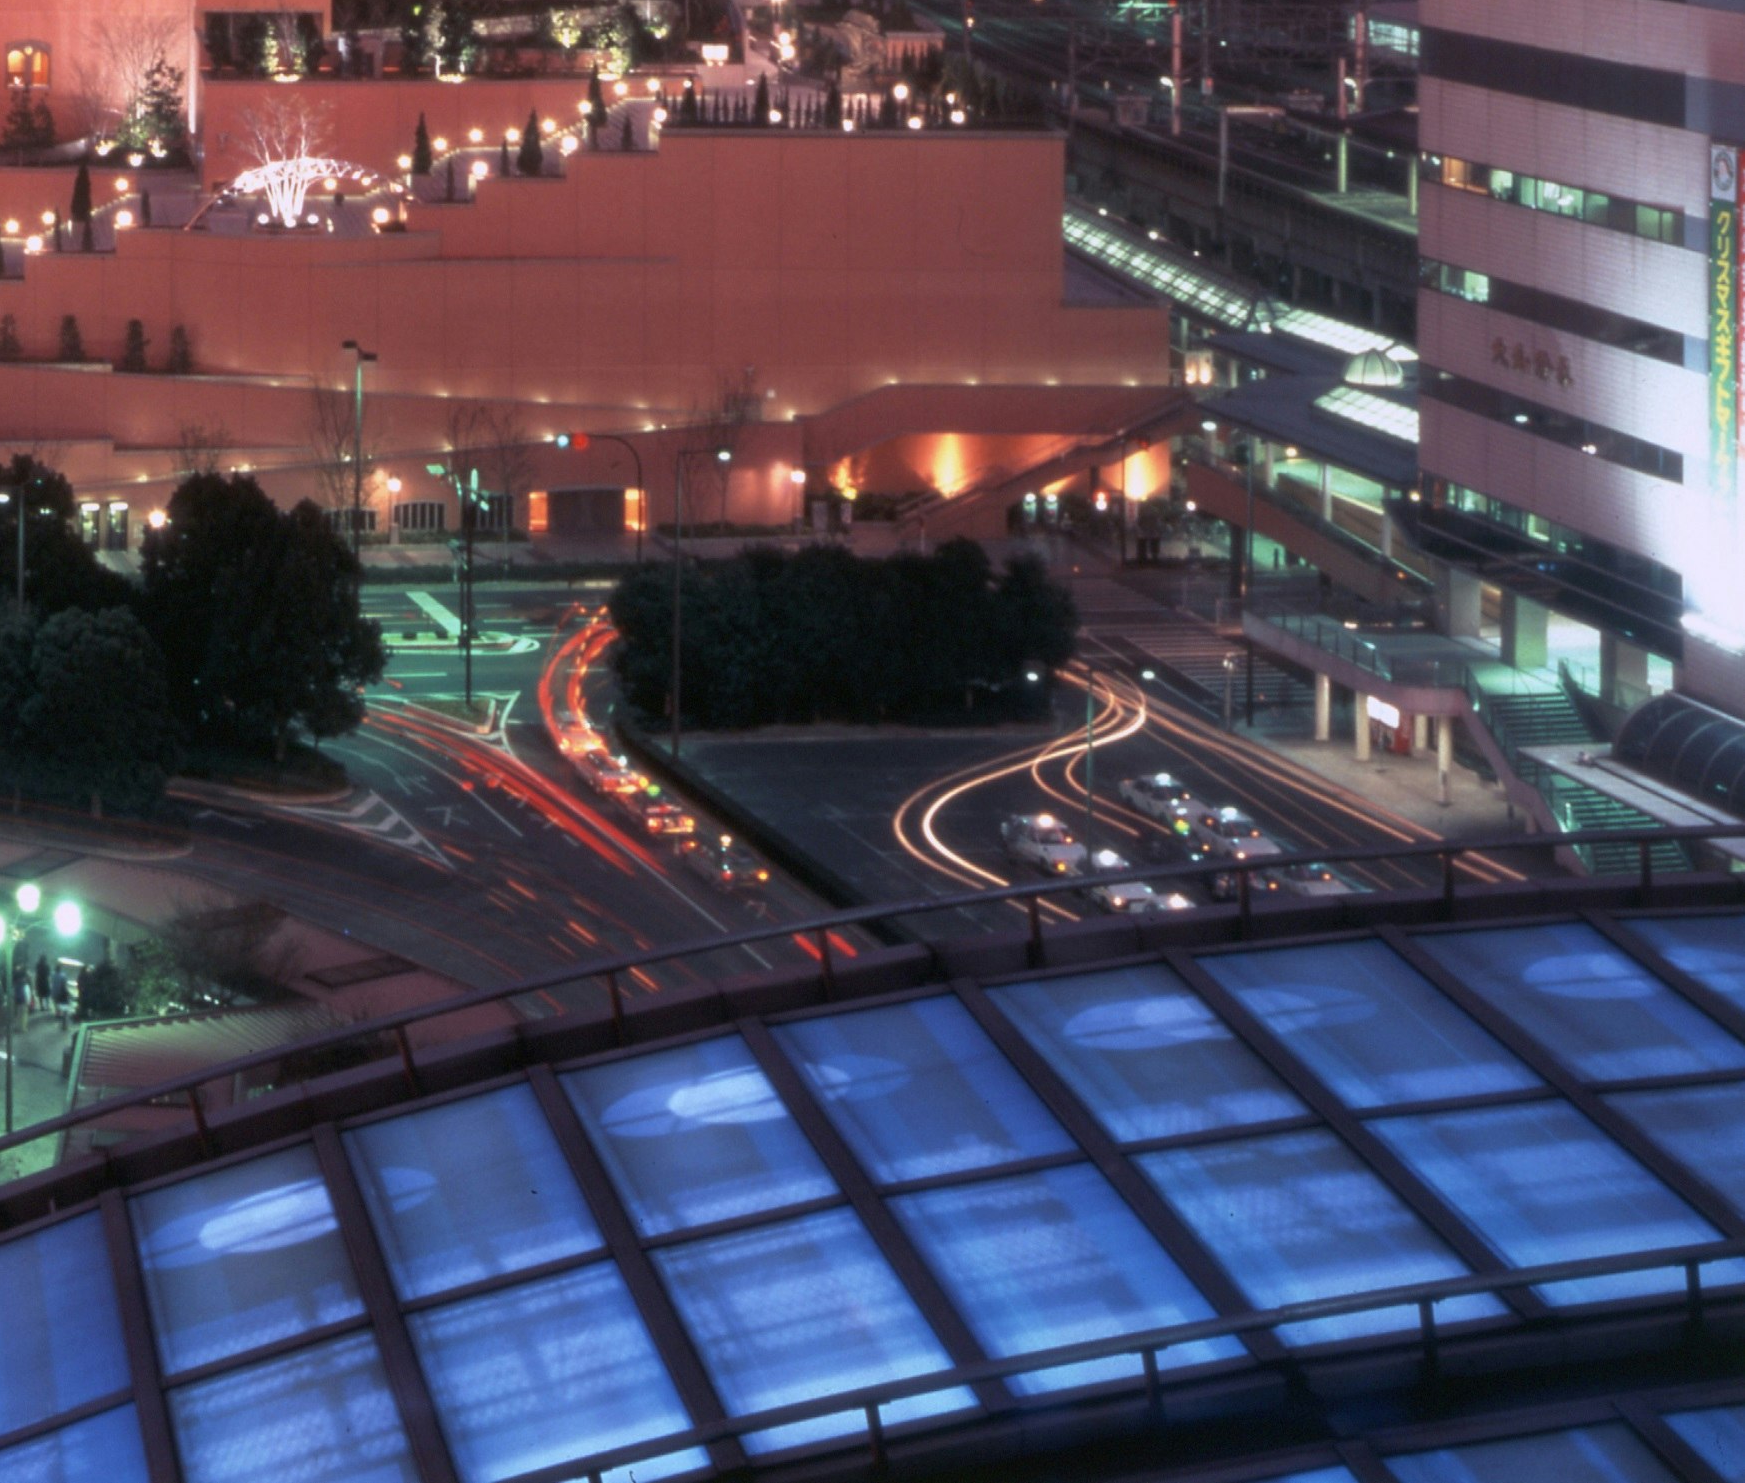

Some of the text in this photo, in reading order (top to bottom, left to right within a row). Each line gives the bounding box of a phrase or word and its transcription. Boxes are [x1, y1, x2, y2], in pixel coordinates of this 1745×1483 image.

[1715, 210, 1731, 506] クリスマスギフトマーケ
